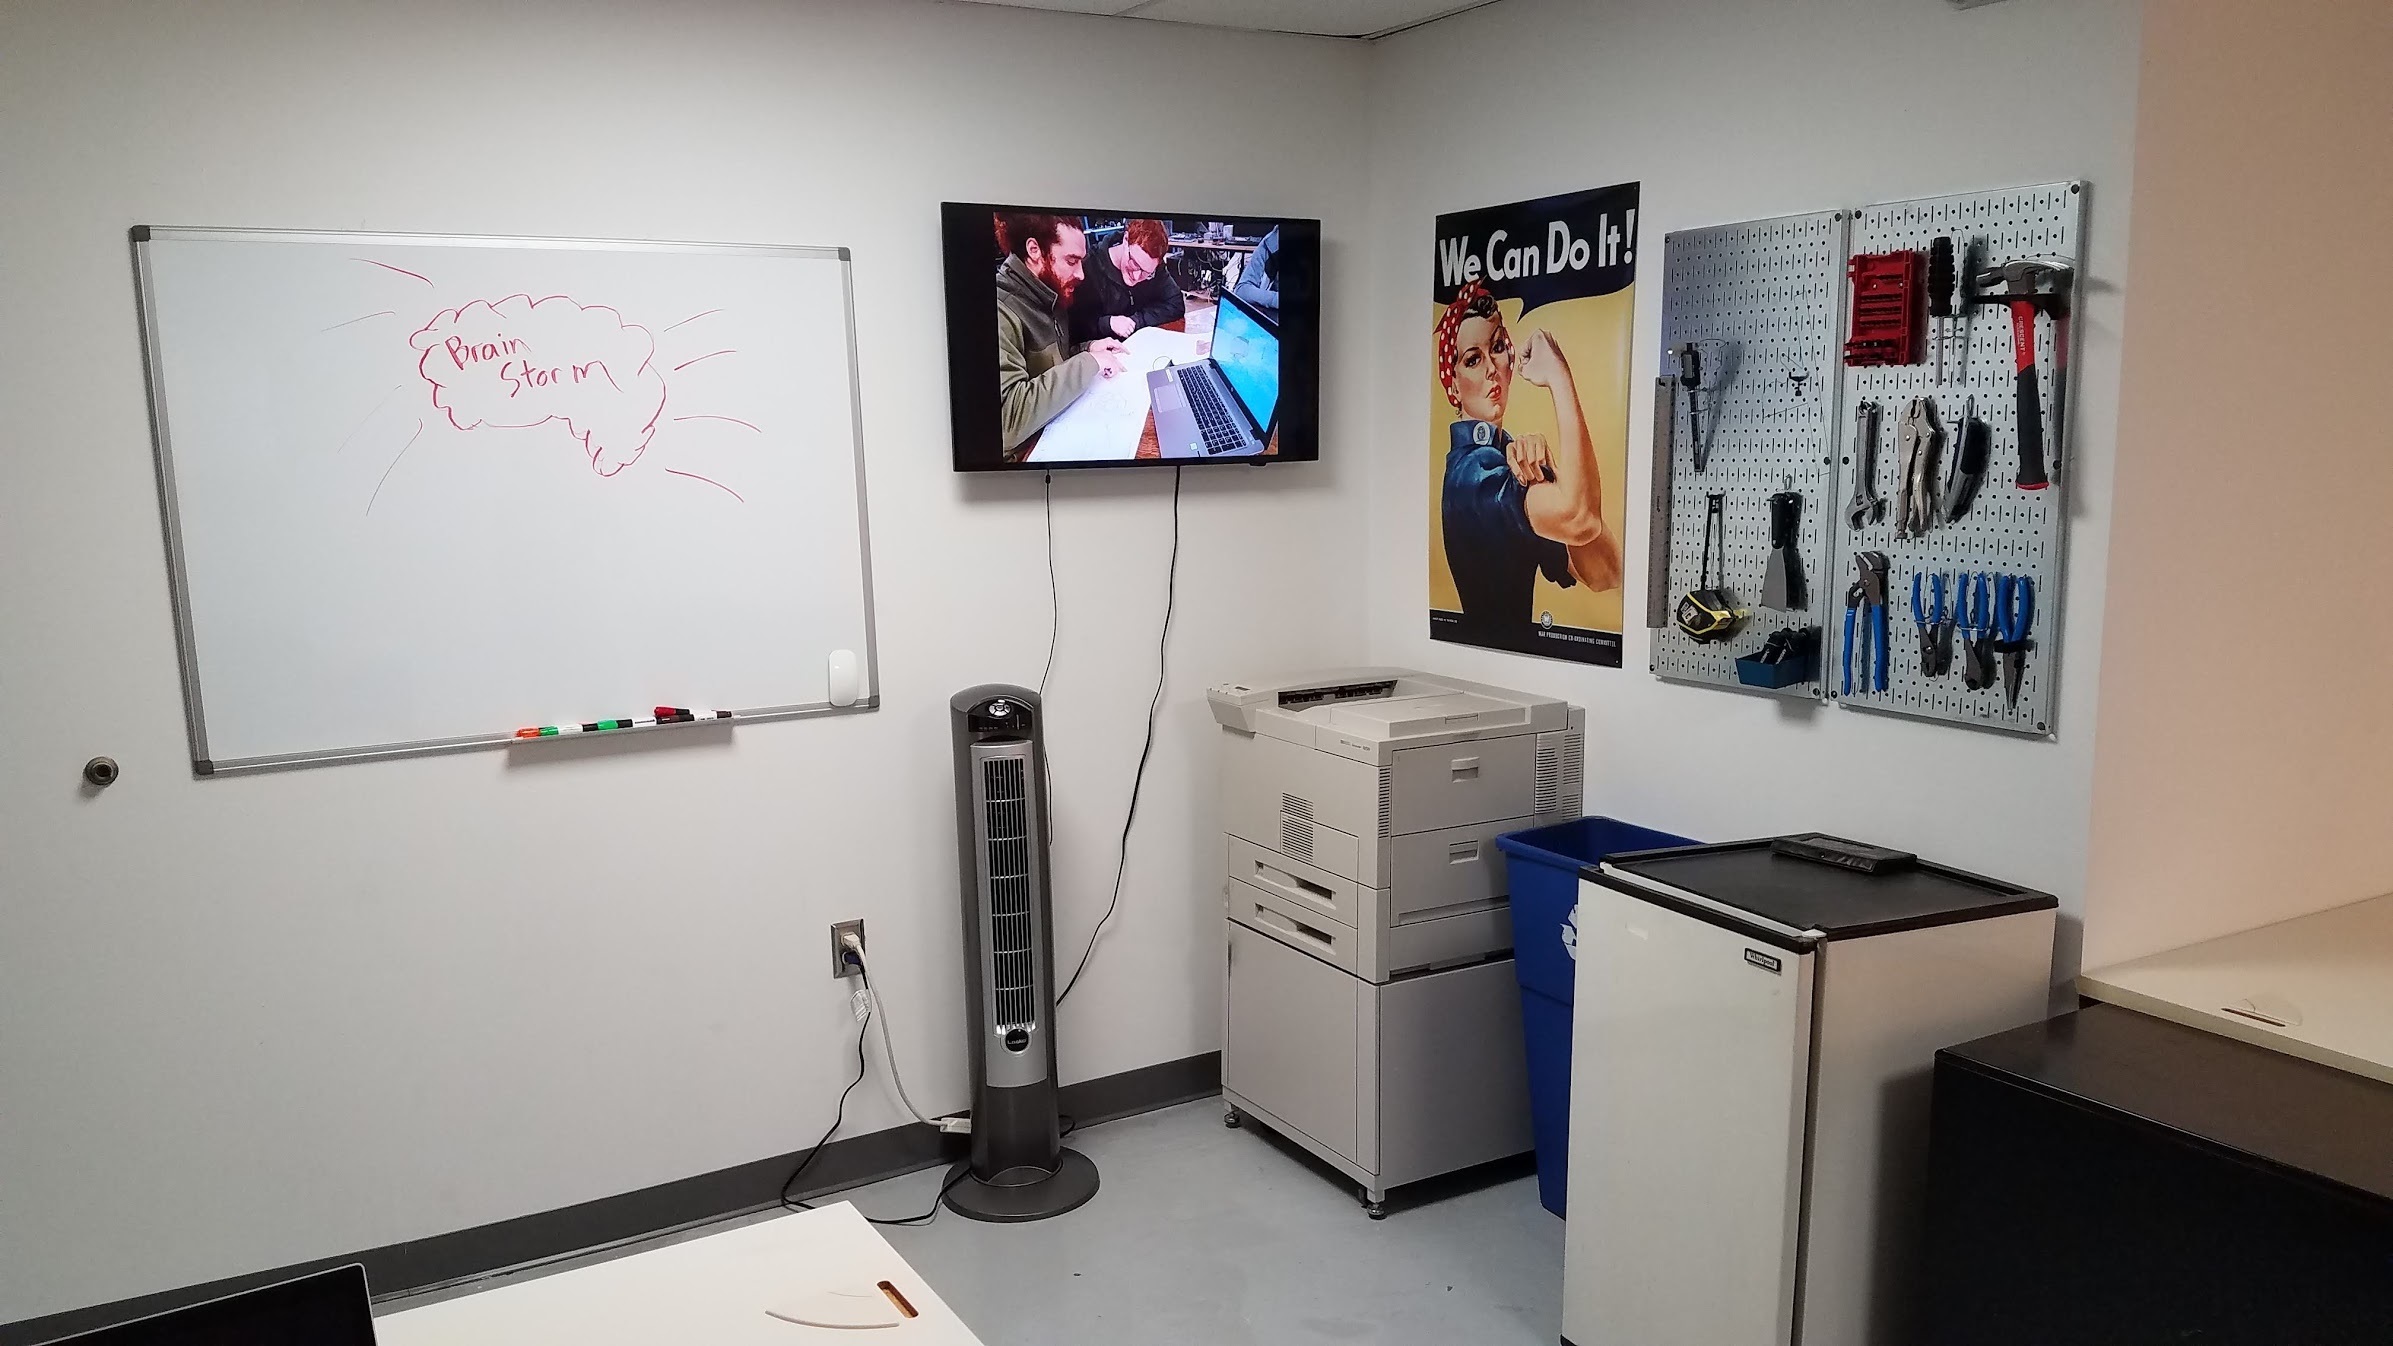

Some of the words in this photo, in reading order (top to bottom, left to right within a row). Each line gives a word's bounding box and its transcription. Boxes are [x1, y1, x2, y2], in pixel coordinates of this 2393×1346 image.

[1439, 235, 1482, 287] We
[1486, 229, 1540, 281] Can
[1546, 220, 1590, 275] Do
[1598, 208, 1636, 268] It!
[445, 332, 532, 370] Brain
[500, 360, 624, 398] Storm
